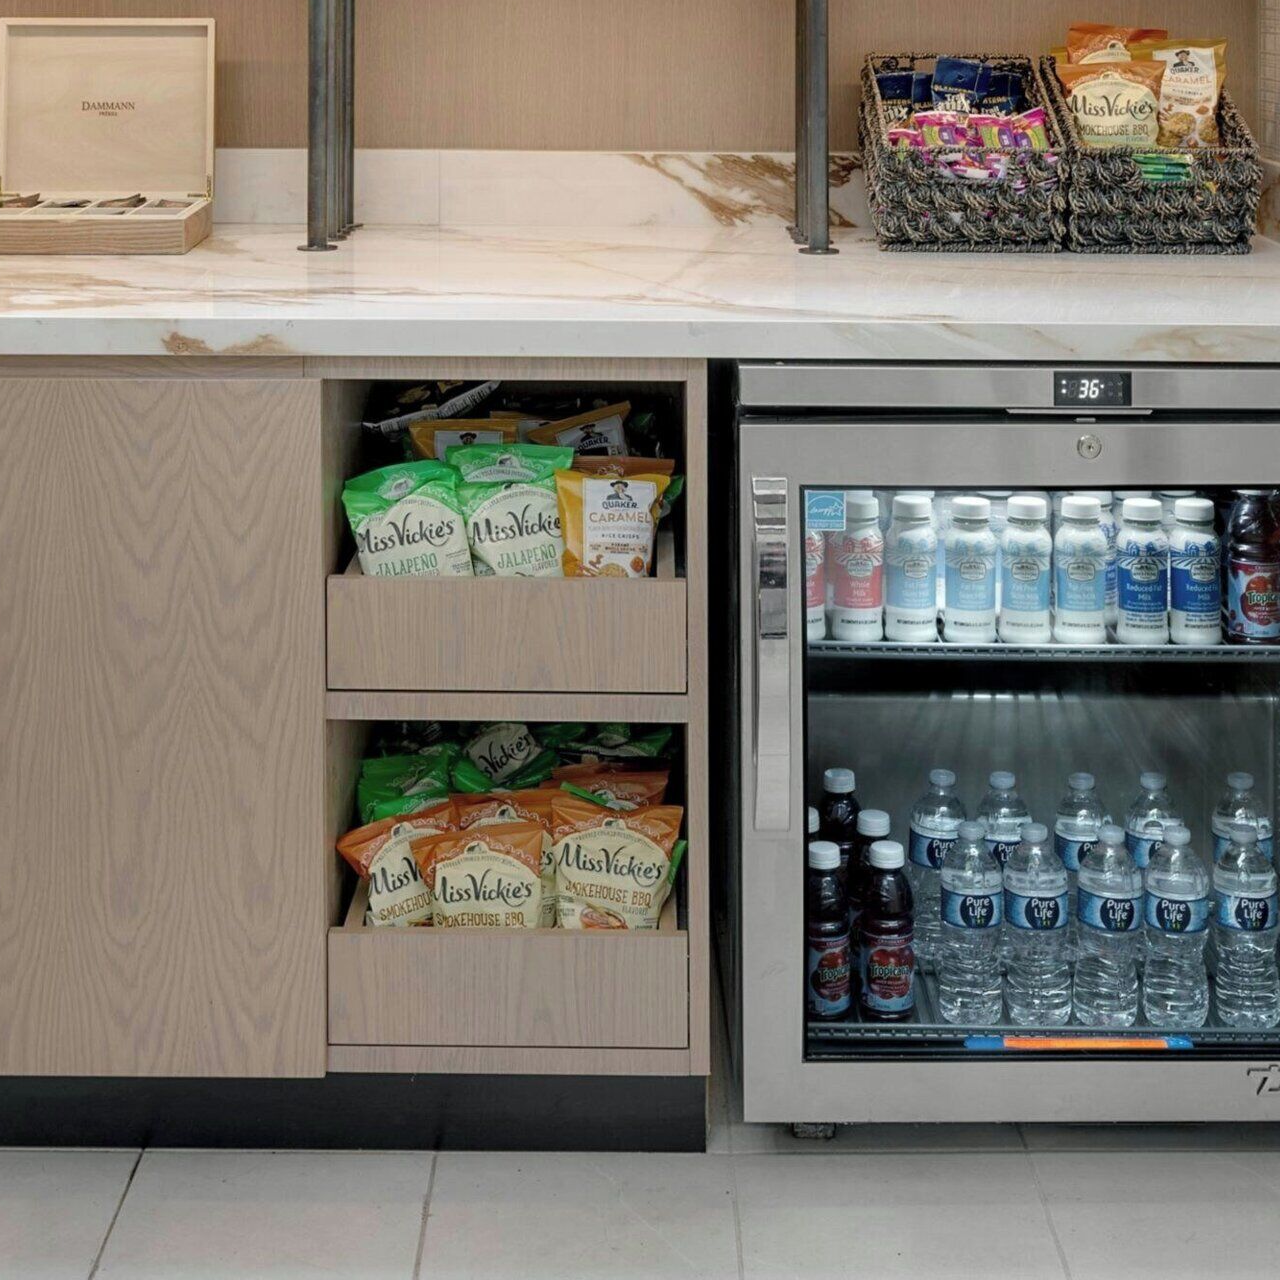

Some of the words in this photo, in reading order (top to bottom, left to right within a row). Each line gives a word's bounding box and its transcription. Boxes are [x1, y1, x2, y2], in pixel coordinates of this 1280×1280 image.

[81, 101, 135, 111] DAMMANN
[1071, 94, 1105, 117] Miss
[1103, 93, 1153, 120] Vickie's
[1132, 125, 1149, 137] BBQ
[602, 500, 639, 509] QUAKER
[589, 512, 651, 524] CARAMEL
[472, 517, 516, 546] Miss
[507, 503, 561, 538] Vickie
[358, 528, 395, 554] Miss
[387, 512, 456, 547] Vickie's
[497, 543, 557, 569] JALAPEÑO
[376, 552, 438, 576] JALAPEÑO
[1126, 583, 1153, 592] Reduced
[933, 839, 955, 849] Pure
[998, 843, 1019, 852] Pur
[935, 848, 947, 859] Lif
[558, 842, 603, 873] Miss
[599, 845, 664, 887] Vickie's
[368, 866, 410, 897] Miss
[432, 876, 471, 904] Miss
[464, 868, 533, 908] Vickie's
[631, 890, 652, 909] BBQ
[966, 896, 990, 907] Pure
[1031, 898, 1056, 908] Pure
[1107, 899, 1131, 910] Pure
[1161, 900, 1186, 911] Pure
[1241, 899, 1265, 909] Pure
[380, 892, 432, 921] SMOKEHOU
[969, 906, 987, 919] Life
[505, 911, 528, 928] BBQ
[1034, 907, 1053, 920] Life
[1109, 909, 1128, 921] Life
[1164, 909, 1183, 922] Life
[1244, 908, 1263, 920] Life
